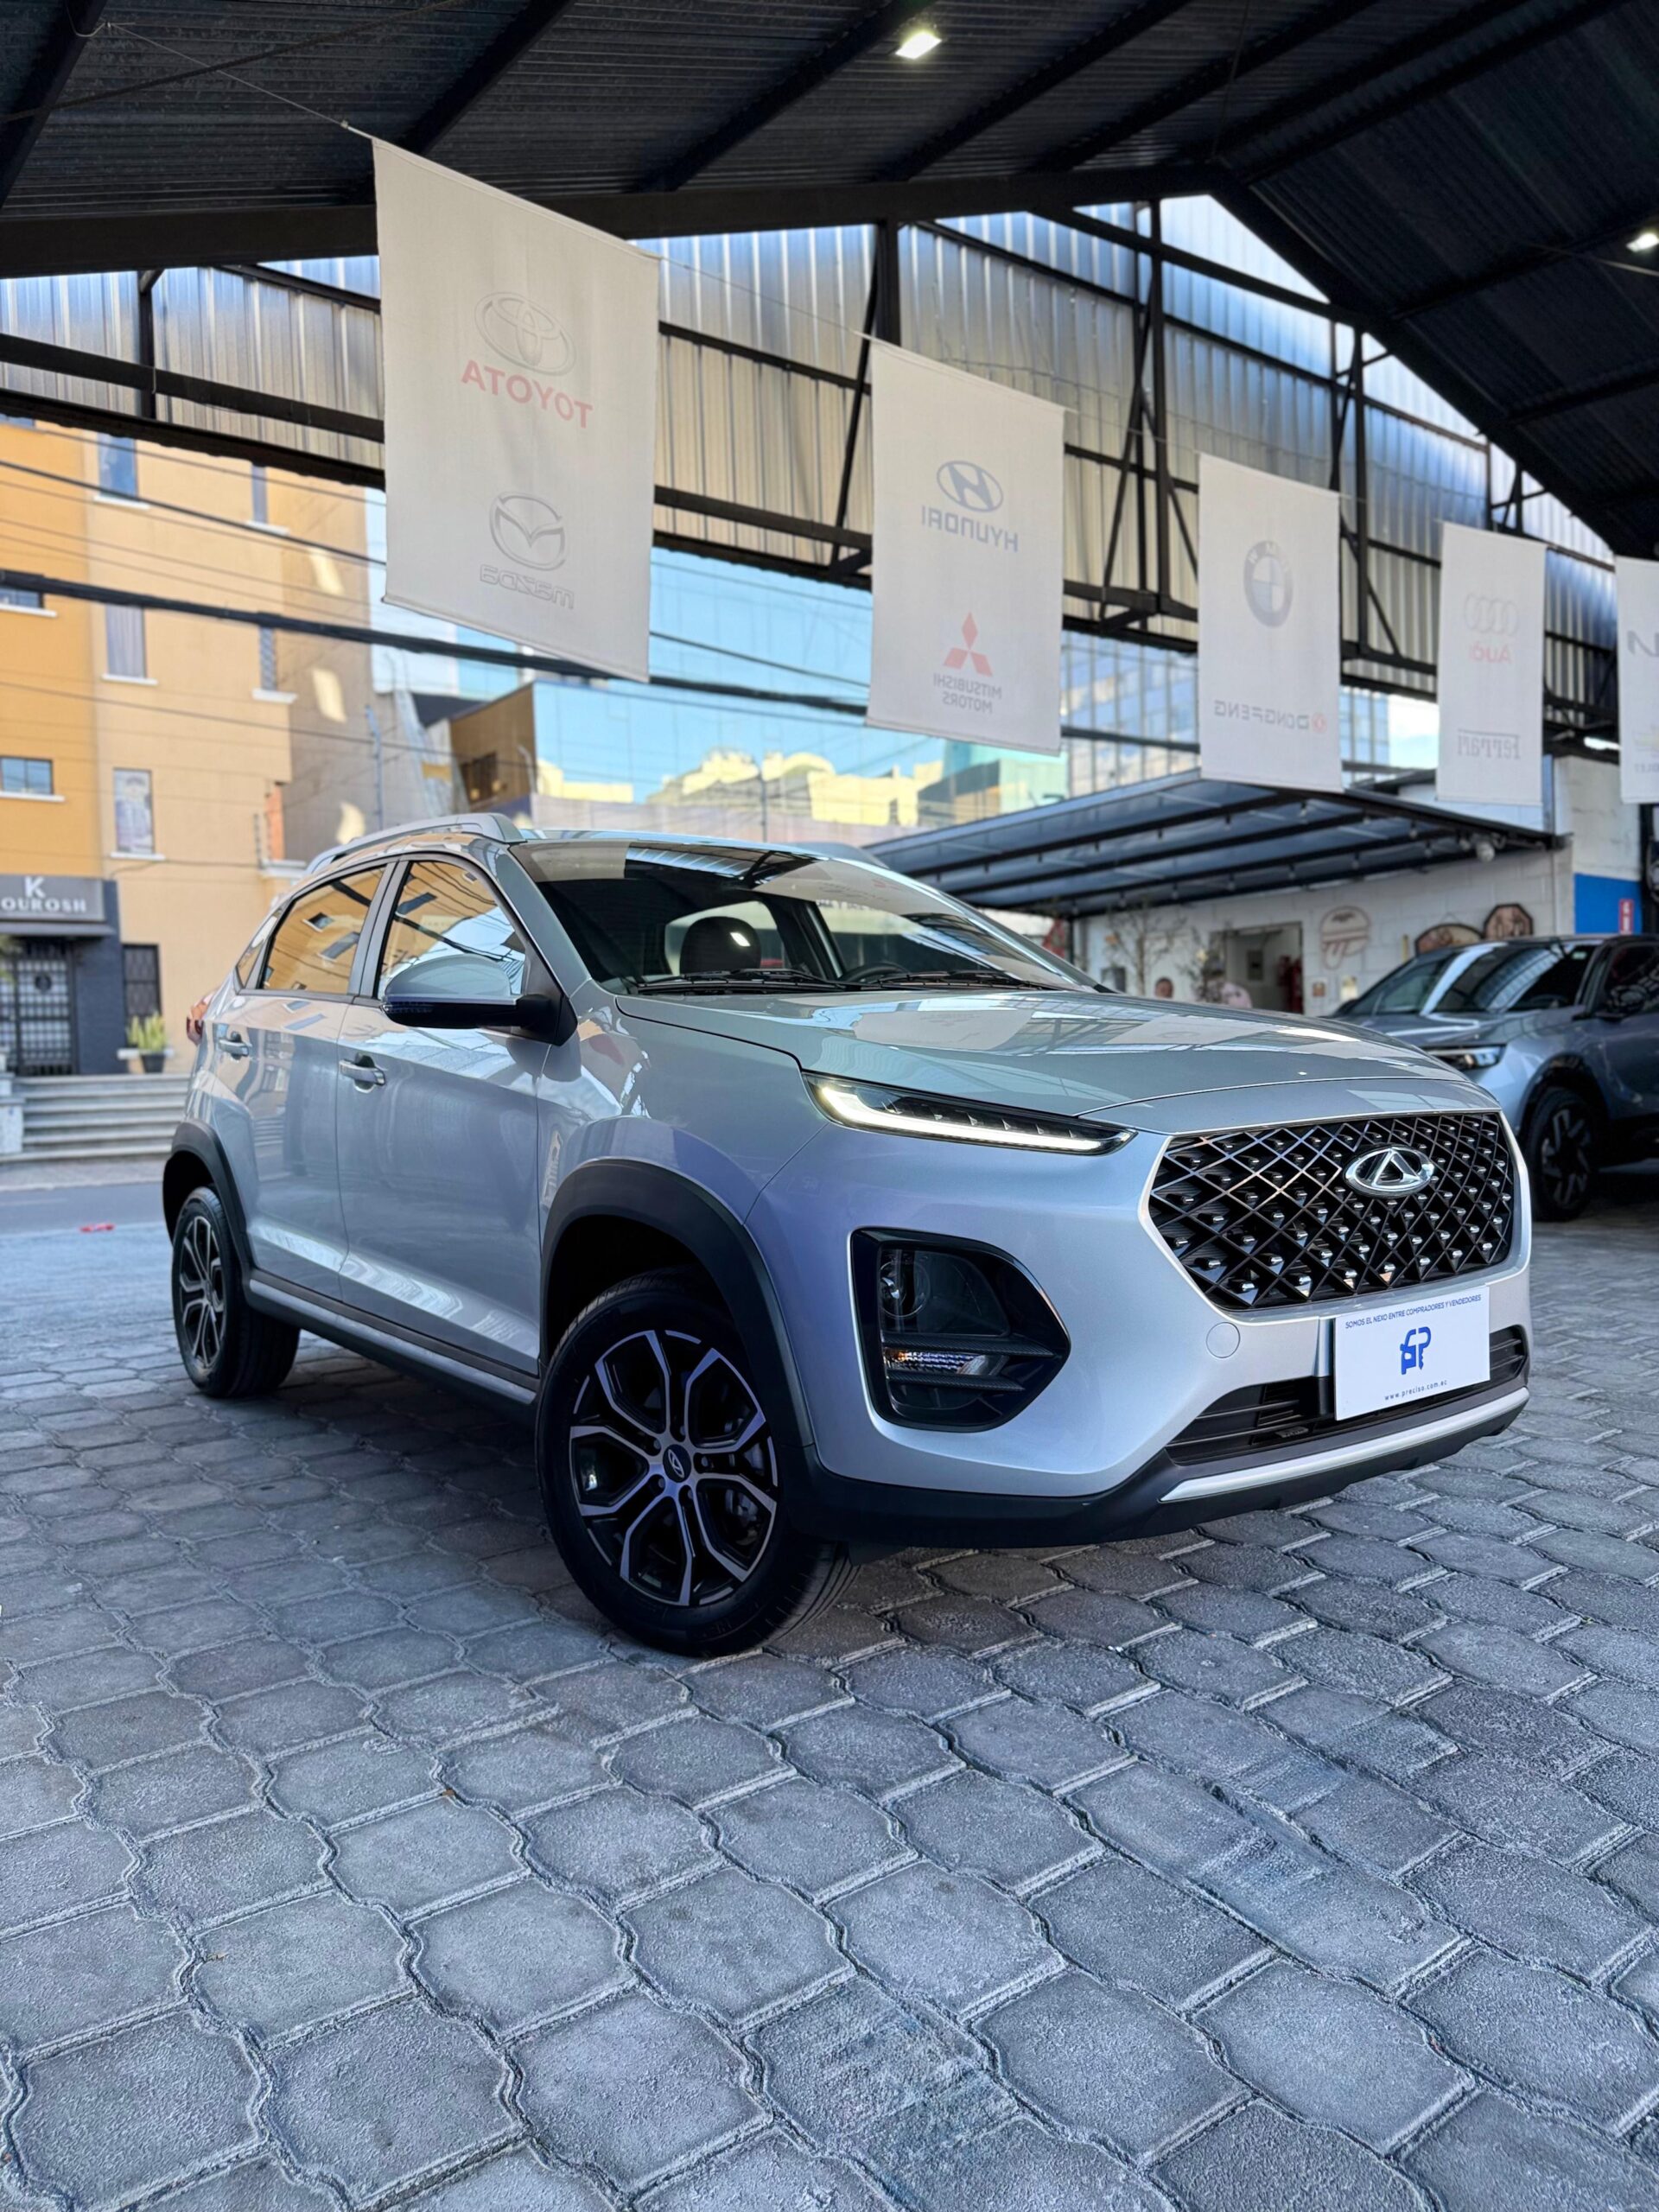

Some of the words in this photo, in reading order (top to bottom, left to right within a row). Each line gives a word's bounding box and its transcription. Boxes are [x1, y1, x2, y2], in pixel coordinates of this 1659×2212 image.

[24, 876, 46, 899] K
[1344, 1318, 1365, 1329] SOMOS
[1373, 1313, 1388, 1323] NEXO
[1388, 1309, 1406, 1320] ENTRE
[1406, 1301, 1445, 1316] COMPRADORES
[1449, 1294, 1482, 1306] VENDEDORES
[1384, 1379, 1447, 1400] www.preciso.com.ec
